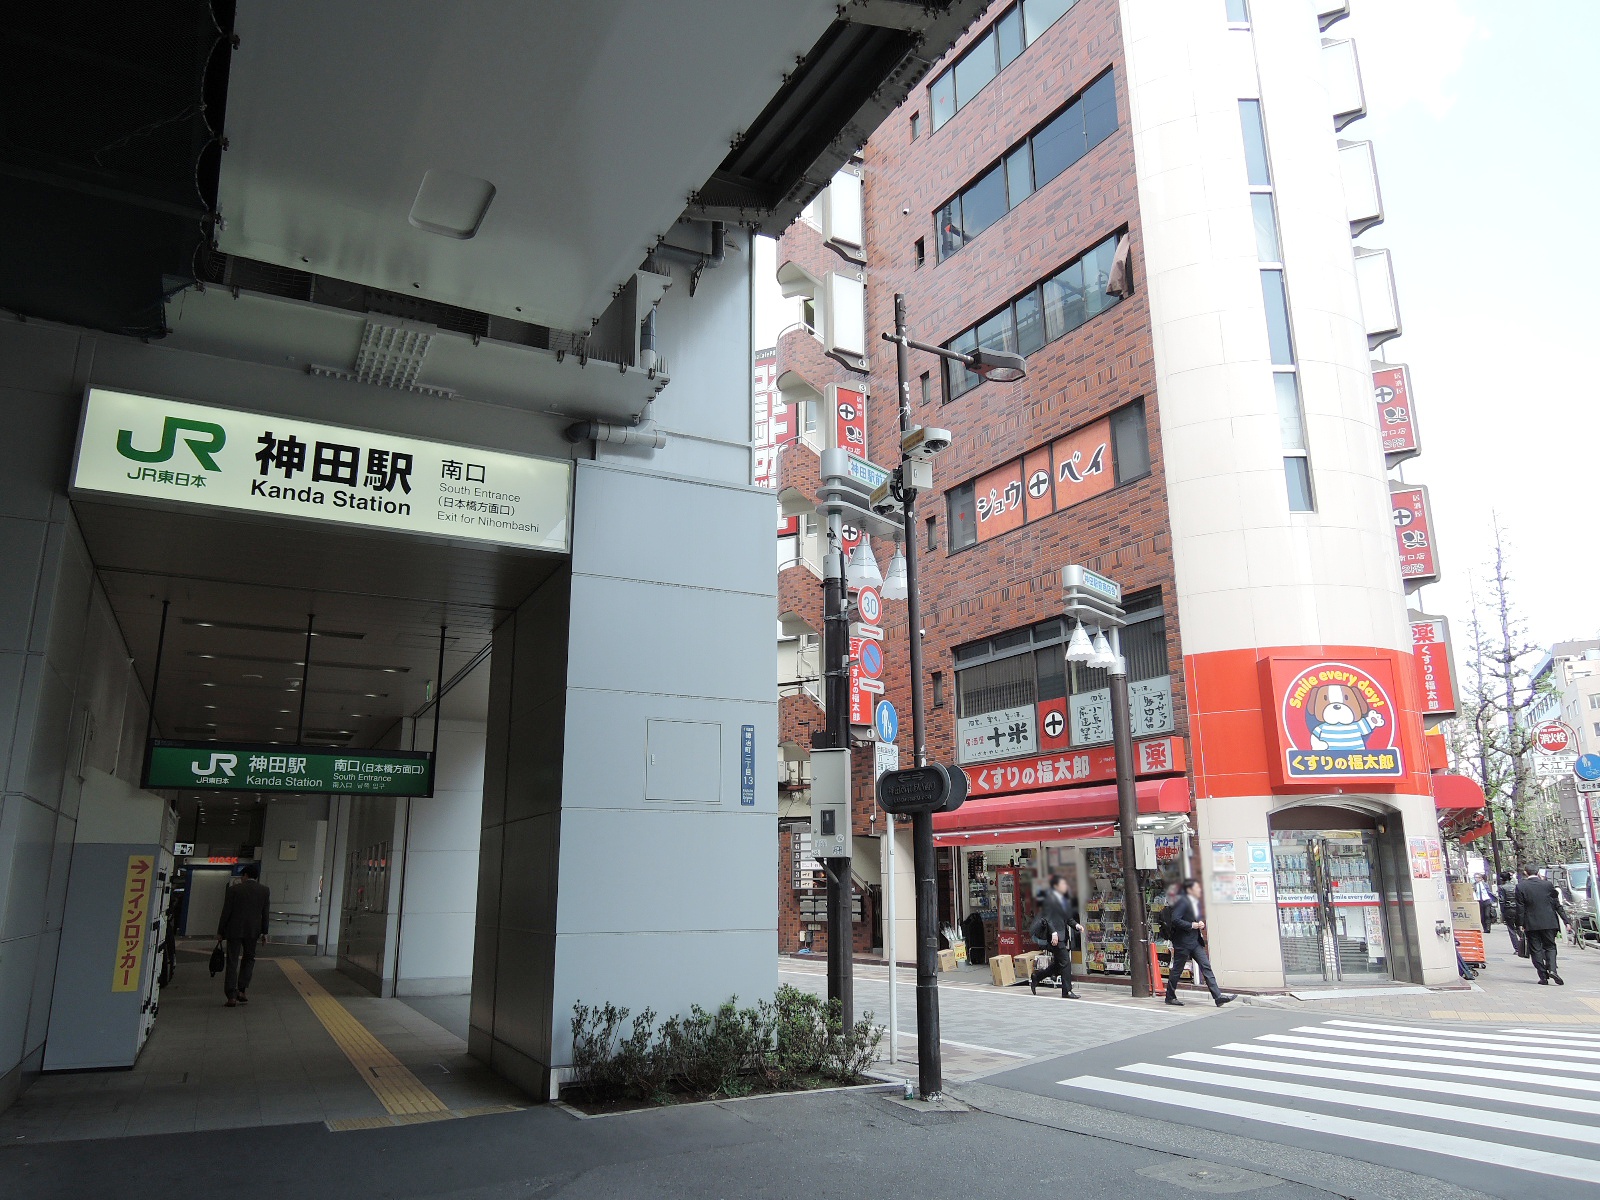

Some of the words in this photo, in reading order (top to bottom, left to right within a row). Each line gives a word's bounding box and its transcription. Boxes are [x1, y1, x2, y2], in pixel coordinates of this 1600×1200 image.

[116, 416, 226, 473] JR
[255, 431, 414, 495] 神田駅
[441, 460, 486, 484] 南口
[126, 467, 208, 489] JR東日本
[977, 480, 1022, 522] ジュウ
[1058, 443, 1107, 482] ベイ
[251, 479, 326, 506] Kanda
[333, 489, 412, 516] Station
[440, 482, 471, 496] South
[474, 488, 520, 502] Entrance
[437, 510, 458, 522] Exit
[461, 514, 475, 524] for
[478, 516, 540, 532] Nihombashi
[864, 596, 876, 616] 30
[1412, 624, 1435, 644] 薬
[1421, 645, 1439, 710] くすりの福太郎
[852, 664, 860, 722] すりの福太郎
[1290, 676, 1318, 708] Smile
[1318, 670, 1358, 686] every
[1358, 680, 1385, 708] day!
[986, 722, 1029, 748] 十米
[1540, 732, 1567, 744] 消火栓
[192, 753, 238, 776] JR
[248, 754, 306, 774] 神田駅
[334, 759, 360, 772] 南口
[1144, 742, 1167, 770] 薬
[1292, 754, 1395, 770] くすりの福太郎
[1538, 760, 1575, 770] 大江戸
[196, 776, 230, 784] JR東日本
[246, 776, 282, 786] Kanda
[286, 776, 323, 787] Station
[358, 774, 392, 782] Entrance
[744, 776, 754, 785] 13
[978, 756, 1090, 790] くすりの福太郎
[208, 856, 238, 864] KIOSK
[120, 878, 147, 986] コインロッカー
